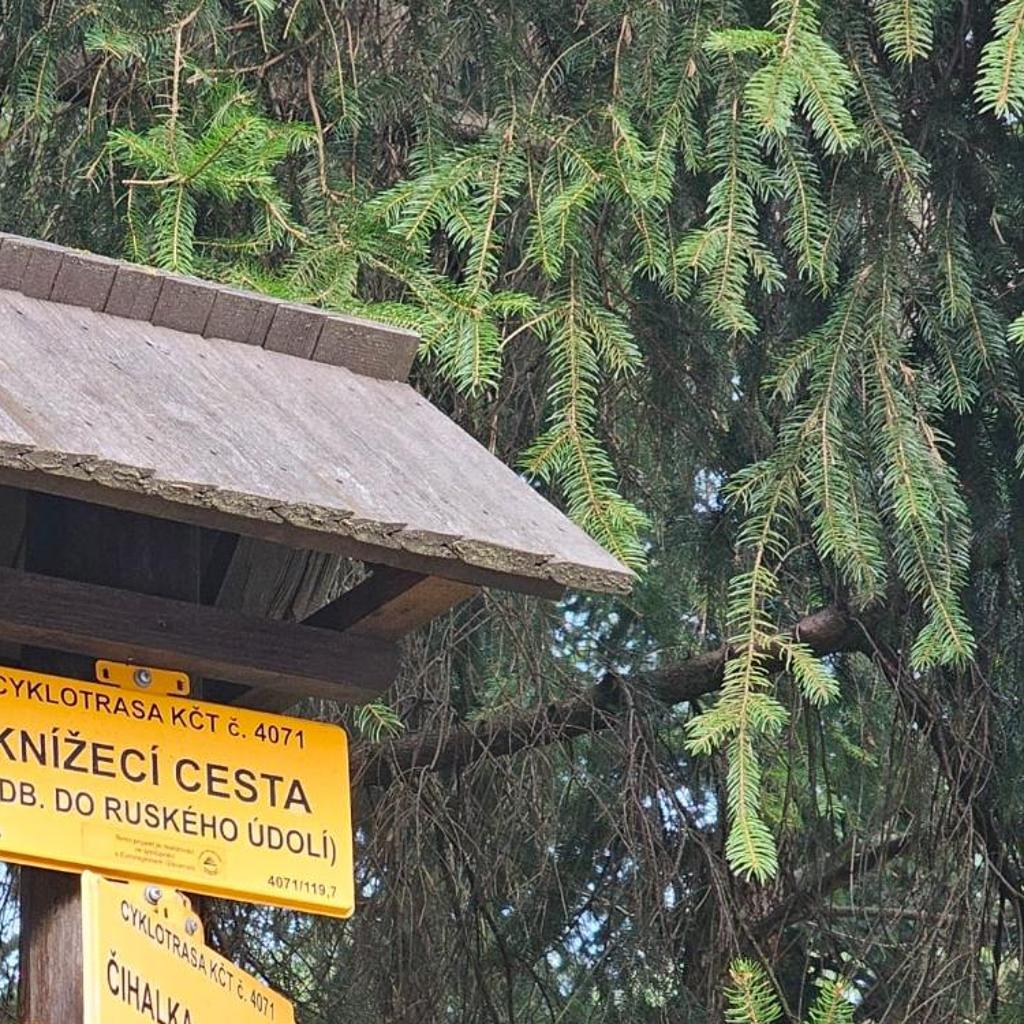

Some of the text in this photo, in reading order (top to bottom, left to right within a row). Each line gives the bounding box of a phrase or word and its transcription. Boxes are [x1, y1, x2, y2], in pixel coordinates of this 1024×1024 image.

[171, 706, 219, 732] KČT
[228, 717, 246, 739] č.
[254, 723, 304, 749] 4071
[176, 758, 313, 814] CESTA
[55, 788, 95, 816] DO
[104, 796, 238, 842] RUSKÉHO
[248, 817, 337, 867] ÚDOLÍ)
[120, 899, 206, 975] CYKLOTRASA
[209, 960, 233, 991] KČT
[250, 990, 275, 1021] 4071
